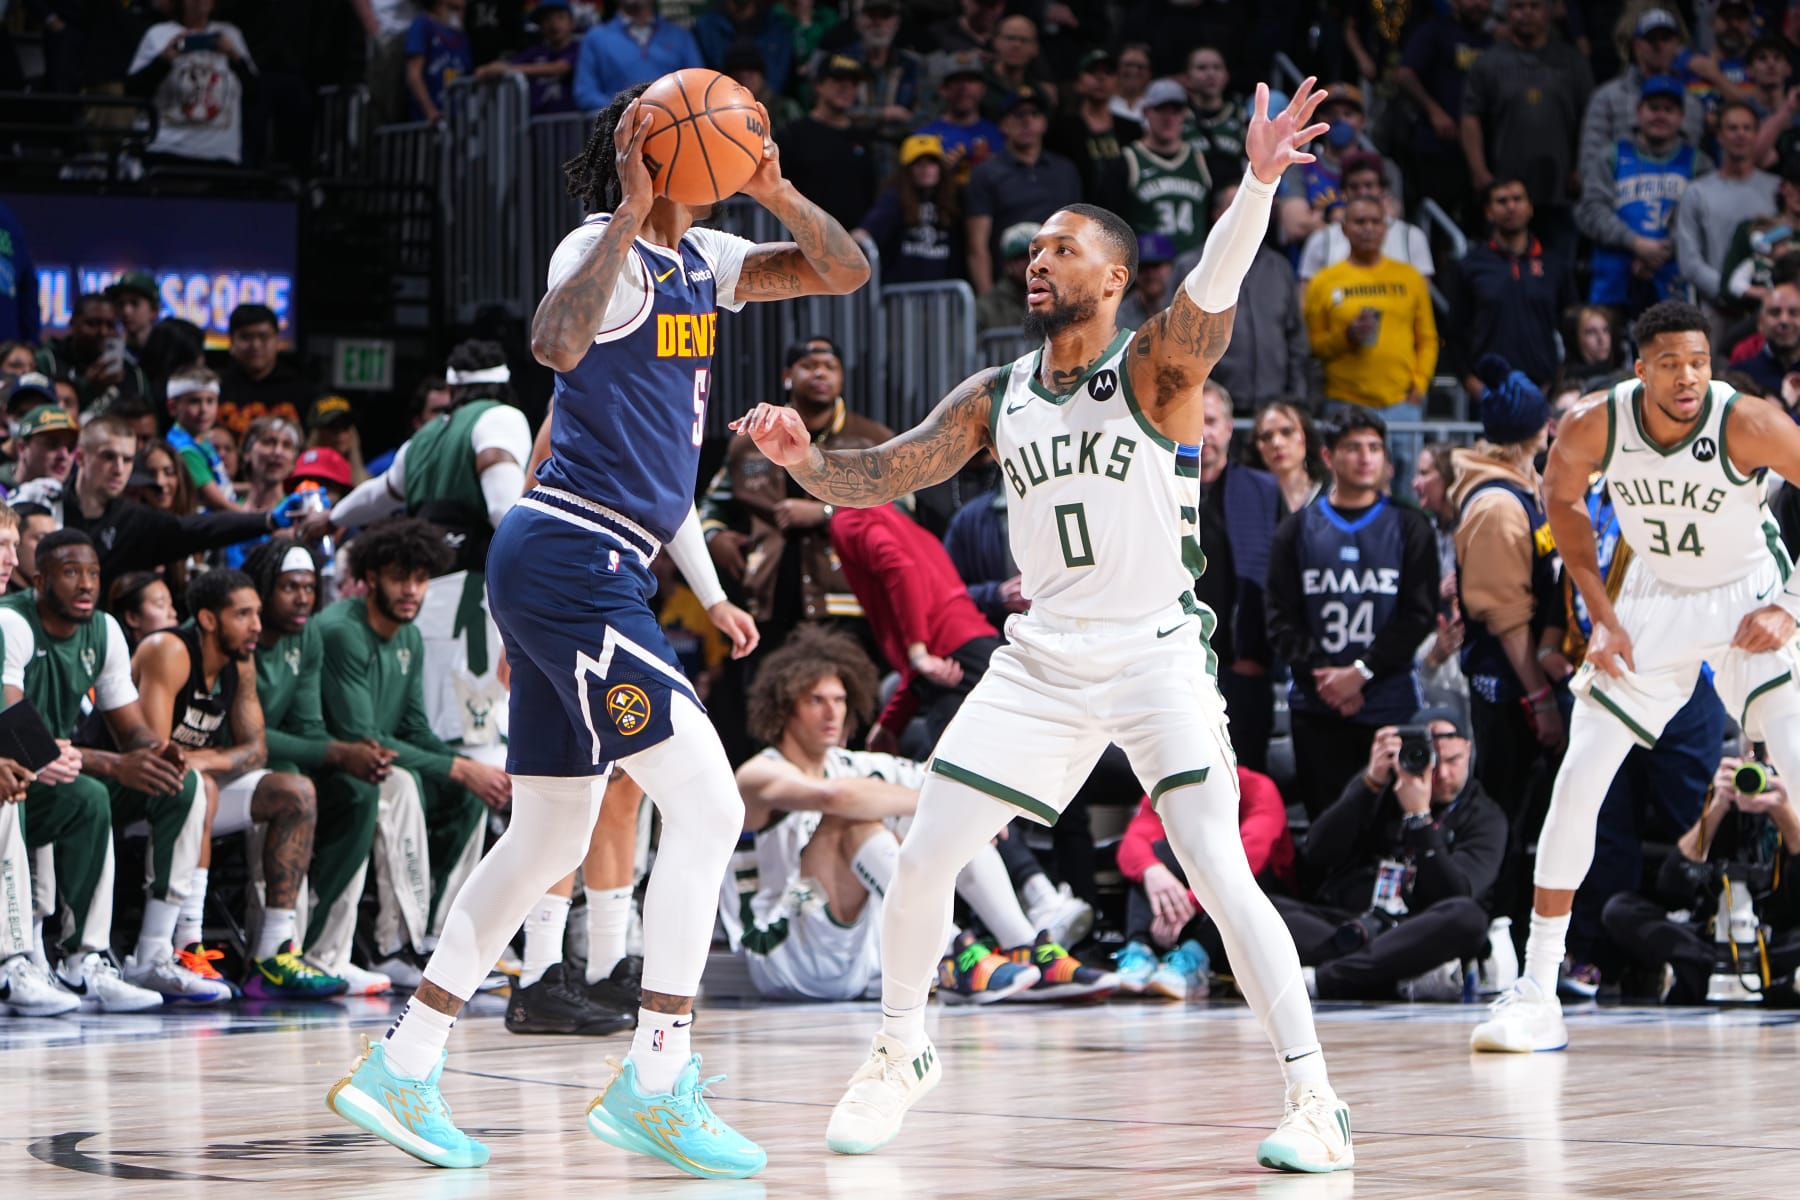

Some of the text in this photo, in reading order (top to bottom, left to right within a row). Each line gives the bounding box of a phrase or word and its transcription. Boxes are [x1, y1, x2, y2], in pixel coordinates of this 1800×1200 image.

[1154, 200, 1195, 235] 34
[344, 347, 385, 384] EXIT
[1003, 431, 1137, 500] BUCKS
[1613, 478, 1728, 514] BUCKS
[1054, 502, 1096, 569] 0
[1643, 517, 1705, 558] 34
[1320, 600, 1377, 654] 34
